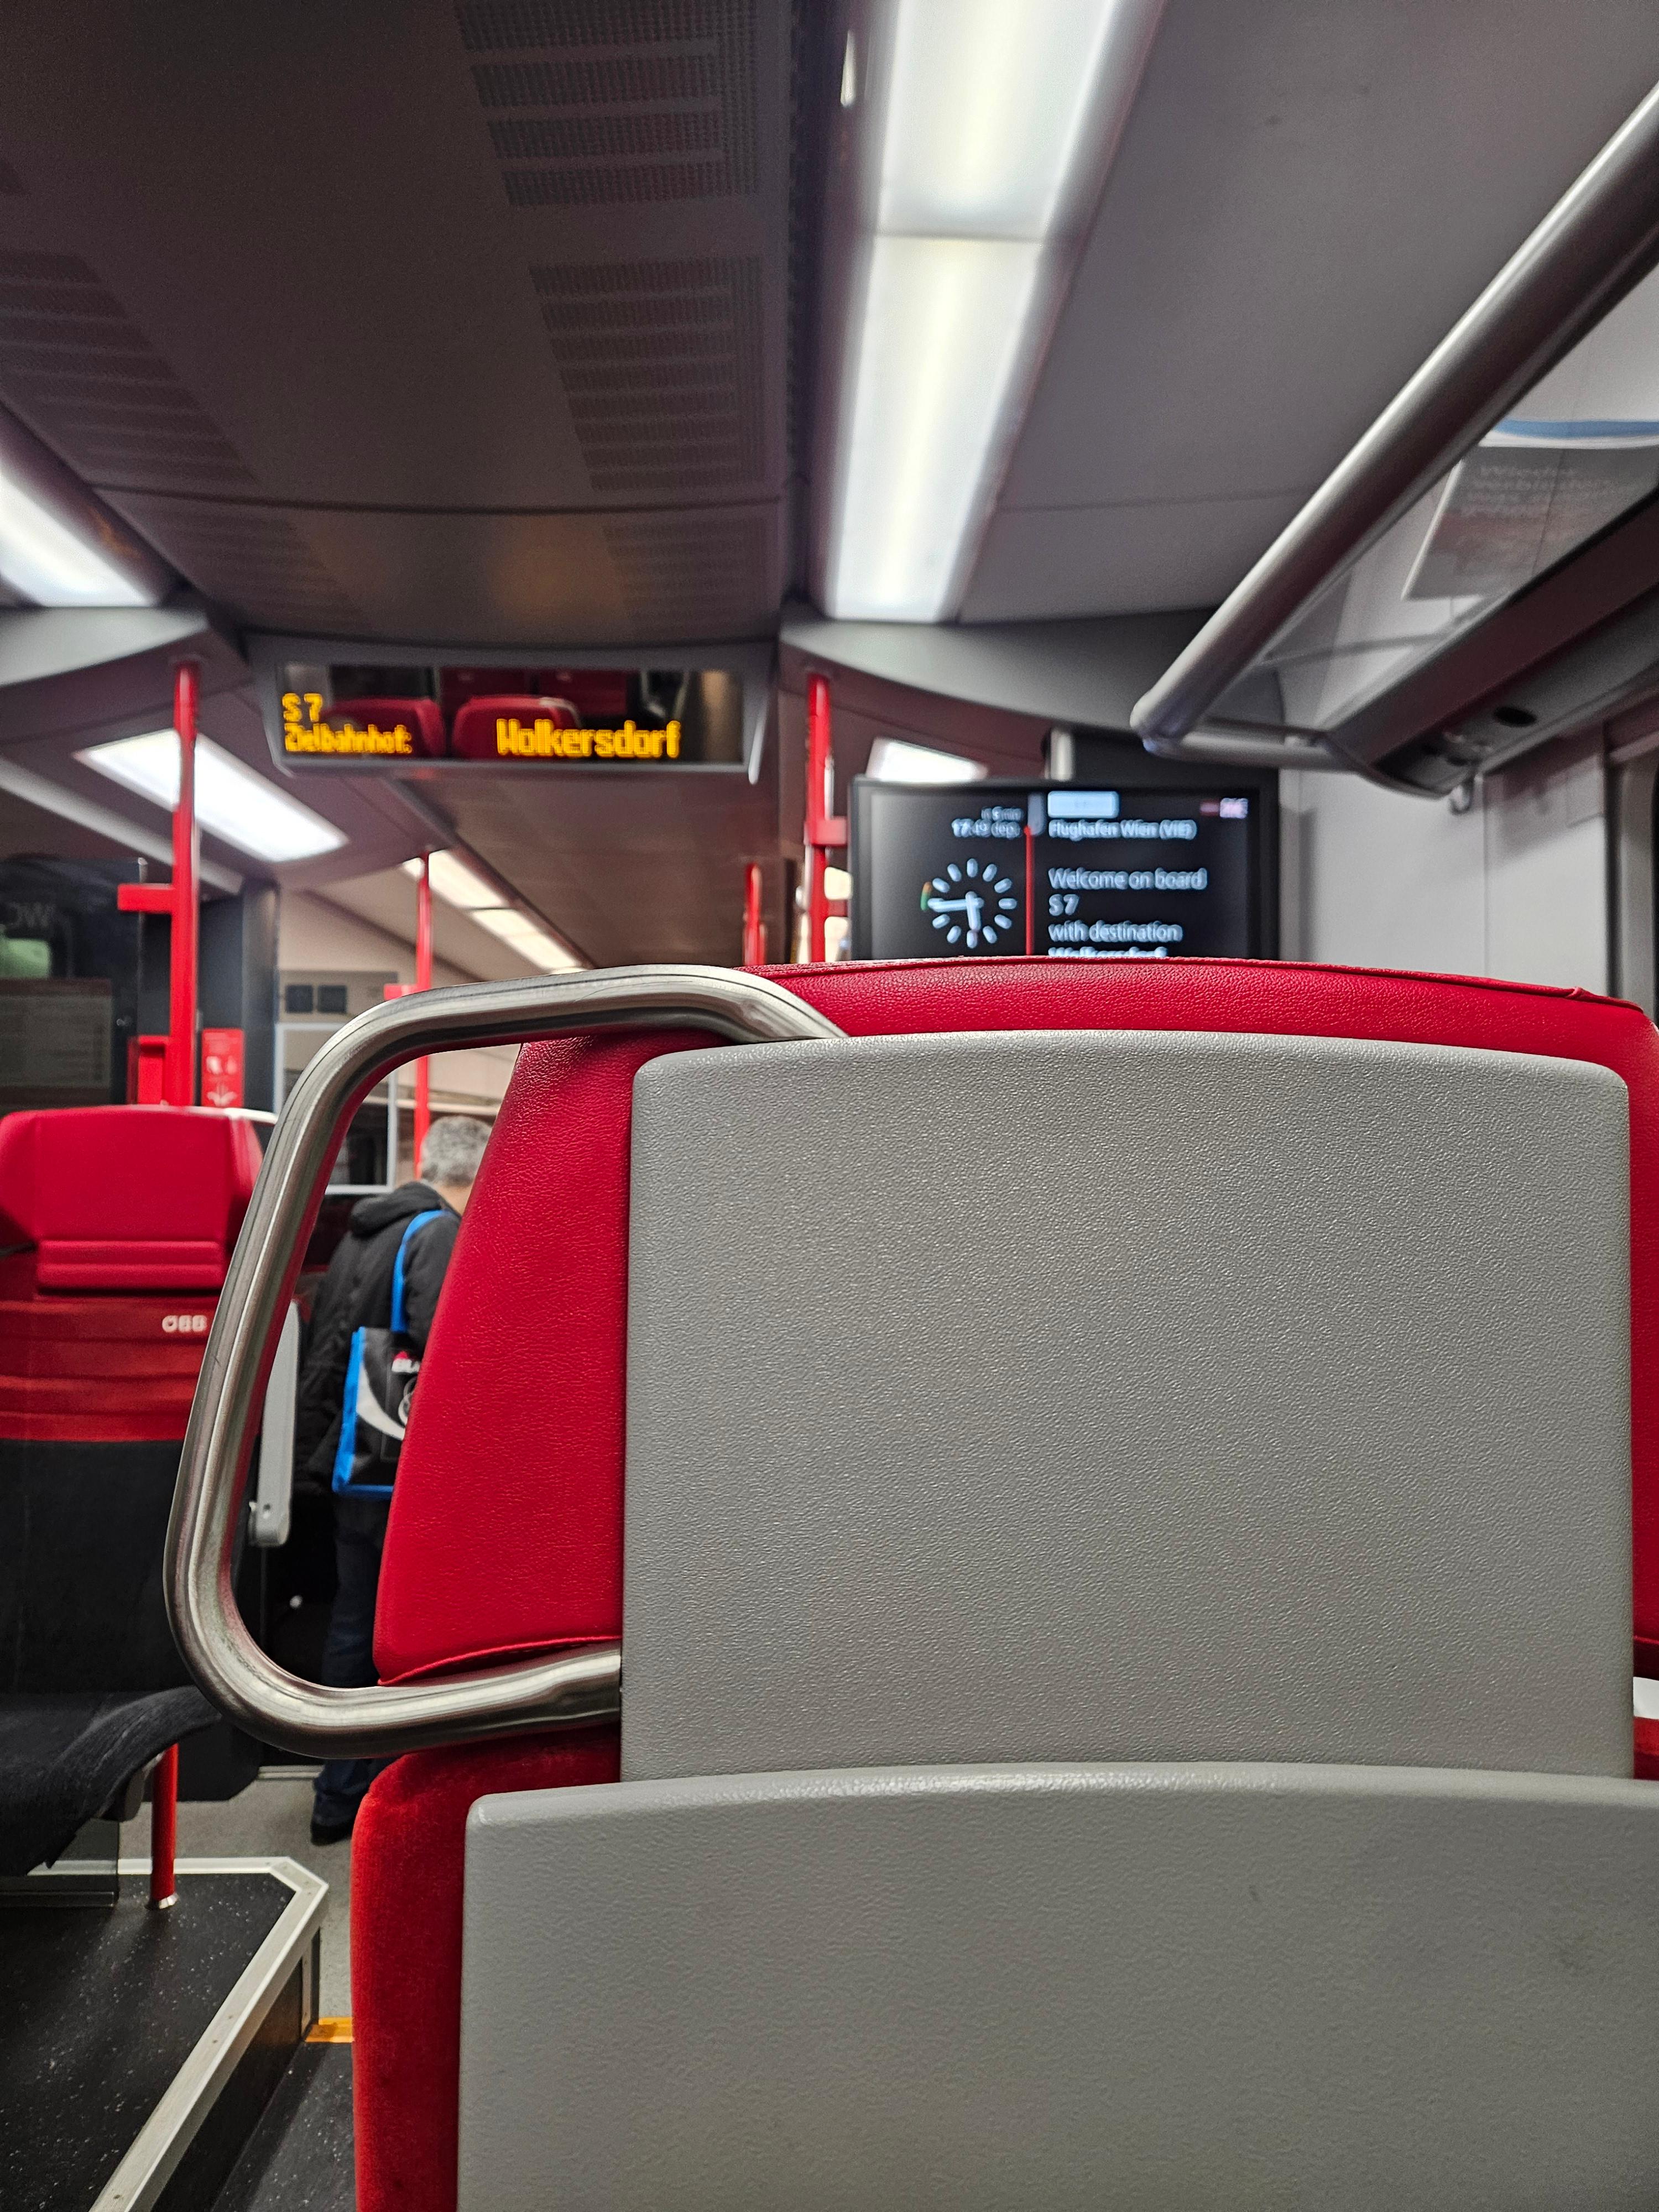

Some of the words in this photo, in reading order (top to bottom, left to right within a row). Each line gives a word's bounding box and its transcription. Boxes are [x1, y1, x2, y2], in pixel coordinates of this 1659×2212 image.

[497, 718, 681, 758] Wolkersdorf
[1048, 820, 1120, 841] Flughafen
[1120, 820, 1160, 838] Wien
[1048, 867, 1129, 889] Welcome
[1129, 871, 1155, 889] on
[1155, 867, 1207, 890] board
[1048, 920, 1089, 942] with
[1089, 920, 1183, 942] destination
